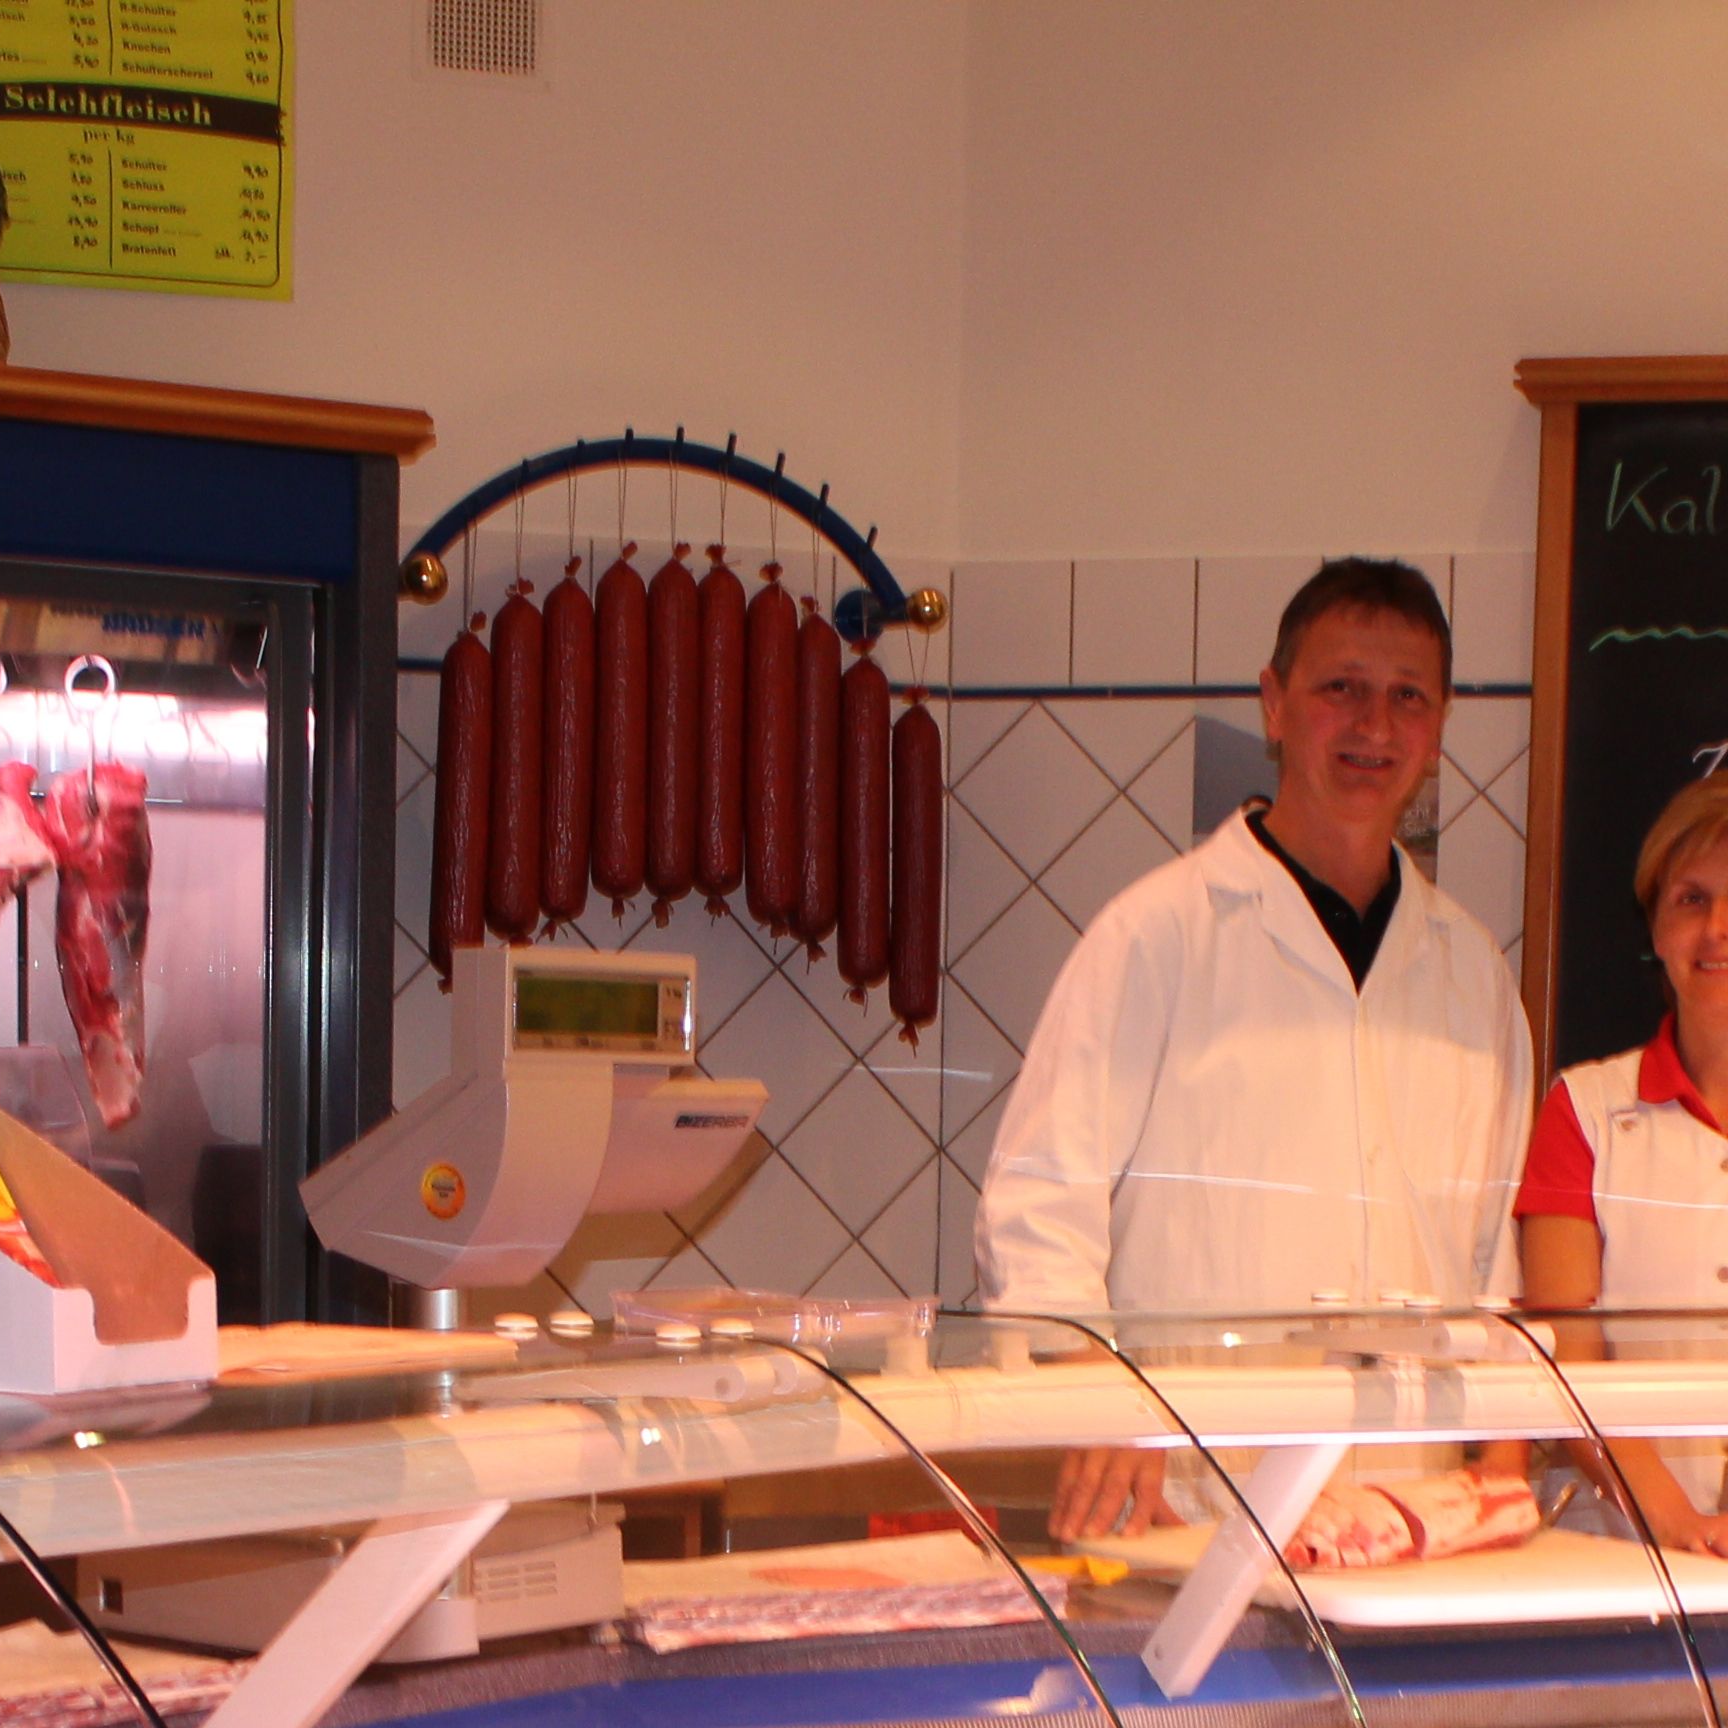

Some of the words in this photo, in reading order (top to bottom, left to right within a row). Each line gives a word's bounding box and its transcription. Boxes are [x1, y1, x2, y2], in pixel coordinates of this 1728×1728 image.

[4, 85, 212, 126] Selchfleisch
[82, 127, 110, 144] per
[115, 128, 135, 146] kg
